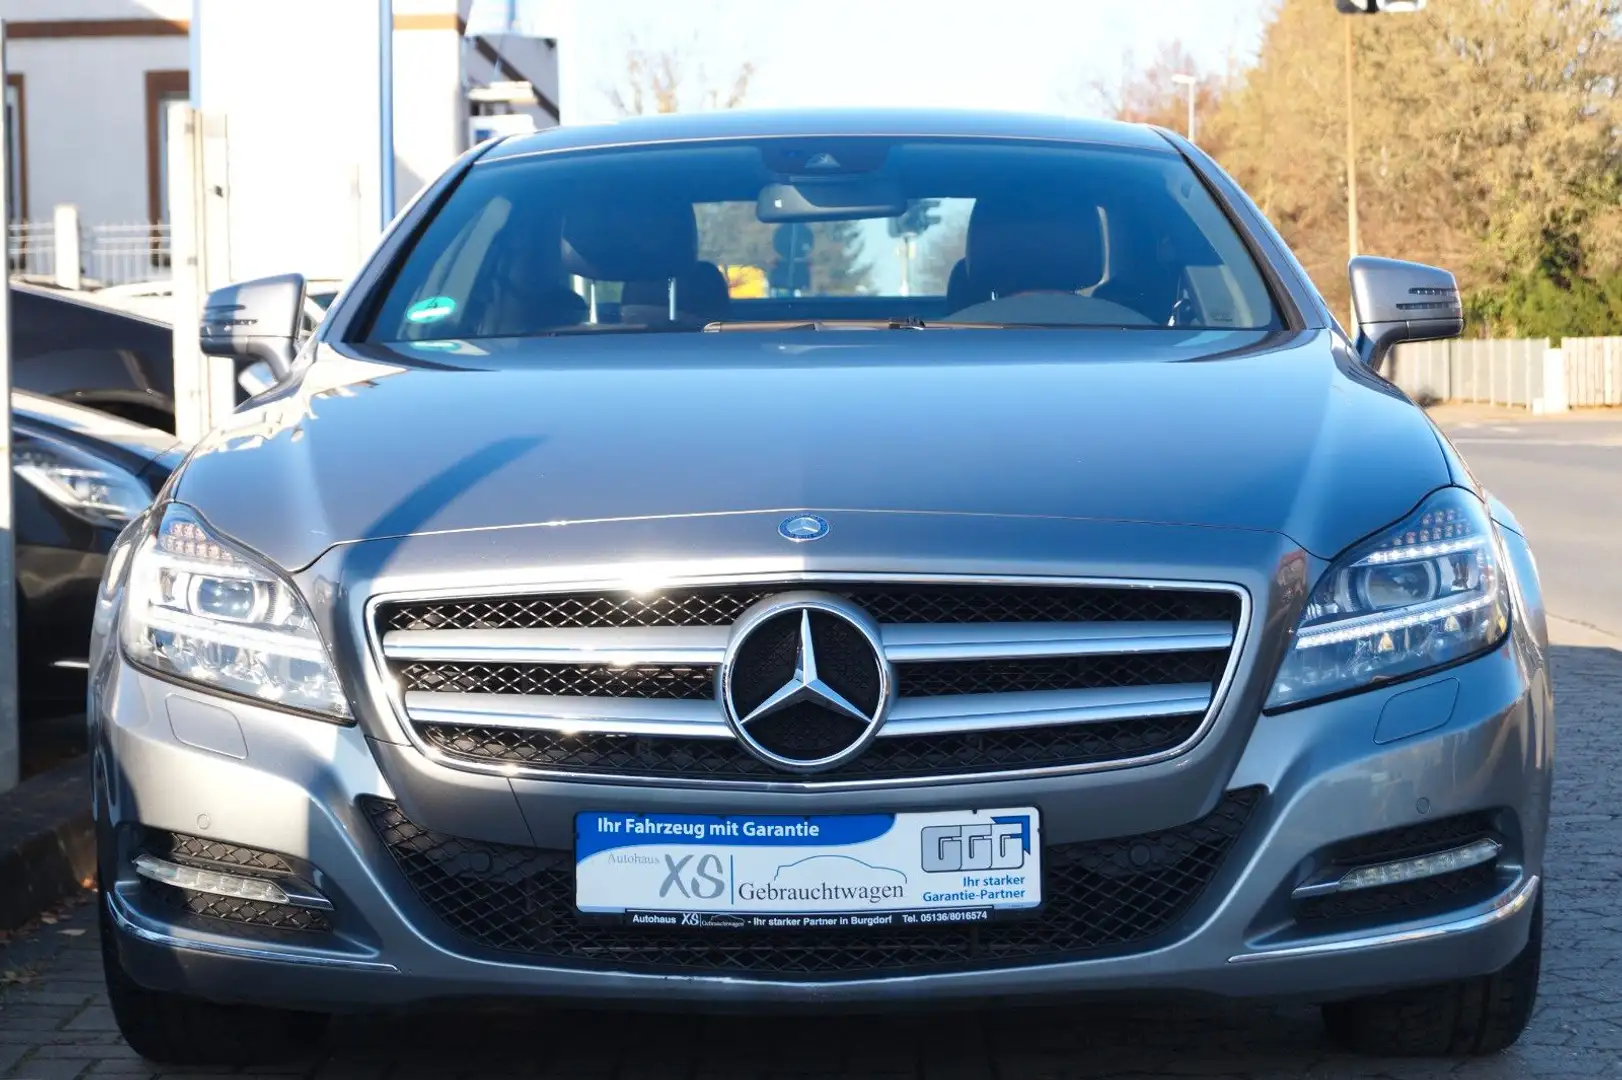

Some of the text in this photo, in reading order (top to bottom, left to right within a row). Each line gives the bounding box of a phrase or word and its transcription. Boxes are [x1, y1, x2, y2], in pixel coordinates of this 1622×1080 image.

[598, 817, 820, 838] Ihr Fahrzeug mit Garantie
[607, 852, 725, 899] Autohaus XS
[963, 875, 1026, 887] Ihr starker
[738, 881, 904, 903] Gebrauchtwagen
[922, 888, 1026, 902] Garantie-Partner
[632, 914, 677, 924] Autohaus
[681, 912, 699, 926] XS
[753, 917, 766, 926] Ihr
[768, 917, 801, 926] starker
[803, 917, 838, 926] Partner
[840, 916, 849, 925] in
[850, 915, 893, 928] Burgdorf
[902, 914, 919, 923] Tel.
[920, 911, 988, 922] 05136/8016574
